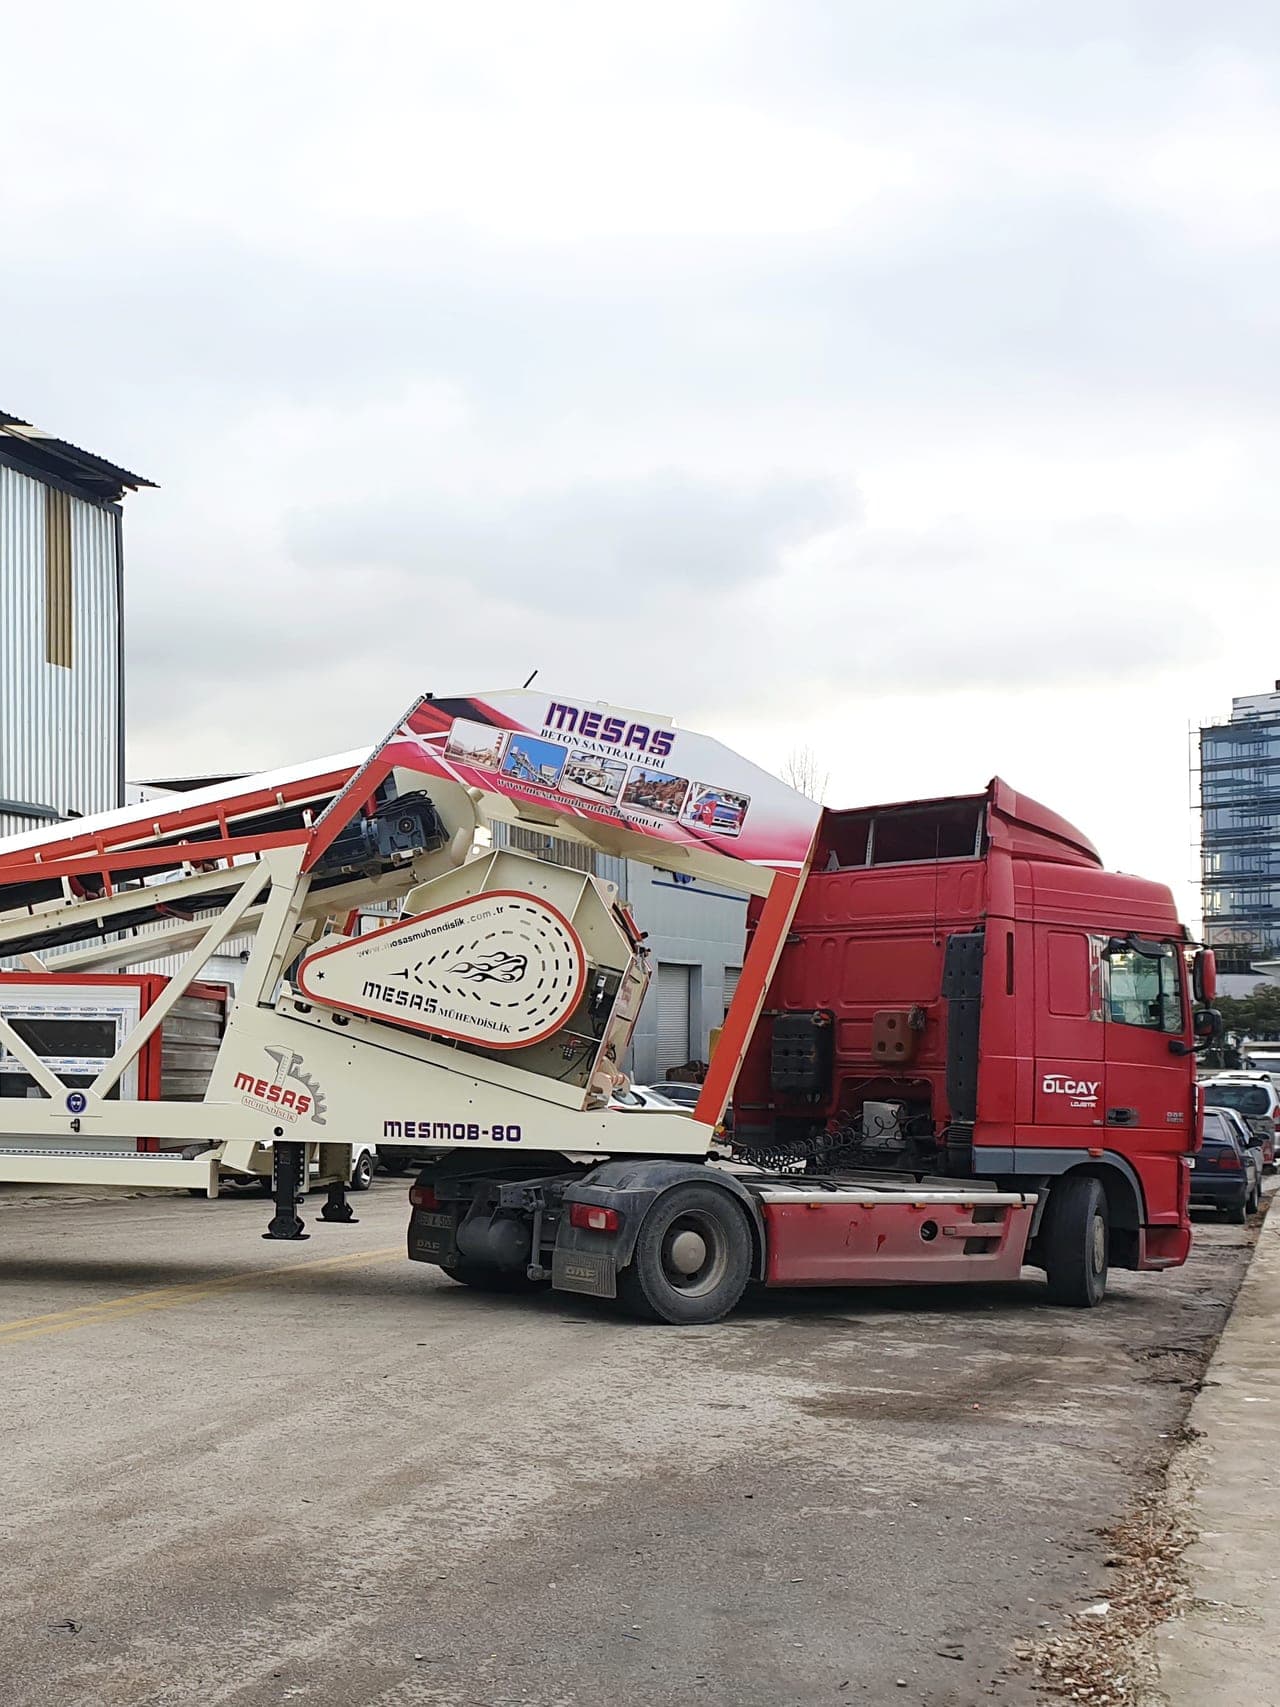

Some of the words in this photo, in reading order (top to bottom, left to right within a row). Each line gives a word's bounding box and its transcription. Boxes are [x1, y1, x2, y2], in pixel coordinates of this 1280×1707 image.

[540, 729, 580, 746] BETON
[581, 739, 666, 769] SANTRALLERİ
[438, 1006, 513, 1034] MÜHENDİSLİK
[233, 1071, 312, 1115] MESAŞ
[1042, 1079, 1099, 1095] OLCAY
[383, 1120, 522, 1142] MESMOB-80
